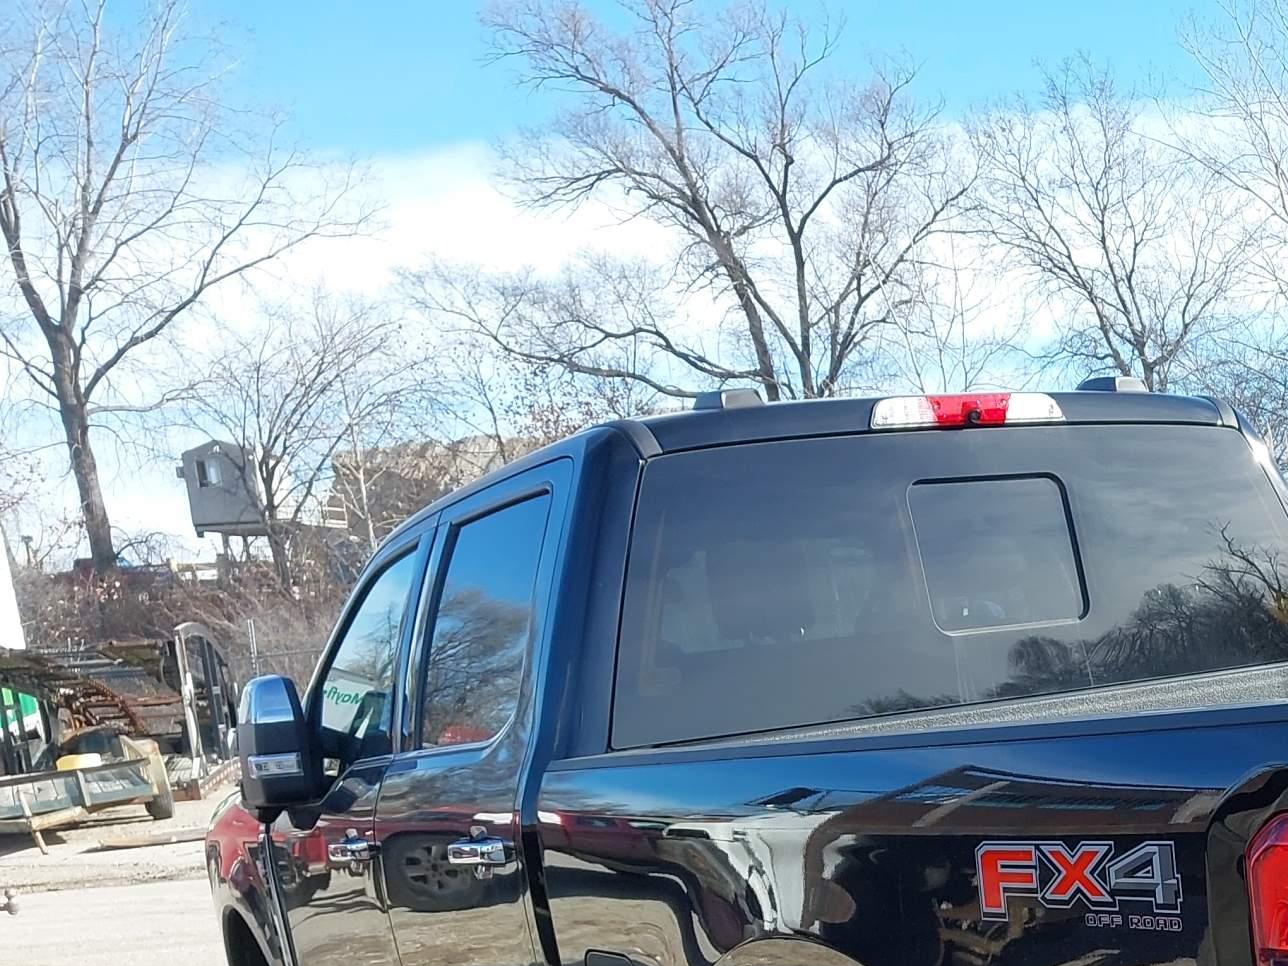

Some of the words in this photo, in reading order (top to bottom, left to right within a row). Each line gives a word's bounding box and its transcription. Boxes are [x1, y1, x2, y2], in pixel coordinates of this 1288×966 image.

[975, 840, 1183, 921] FX4
[1085, 914, 1123, 927] OFF
[1129, 915, 1183, 931] ROAD
